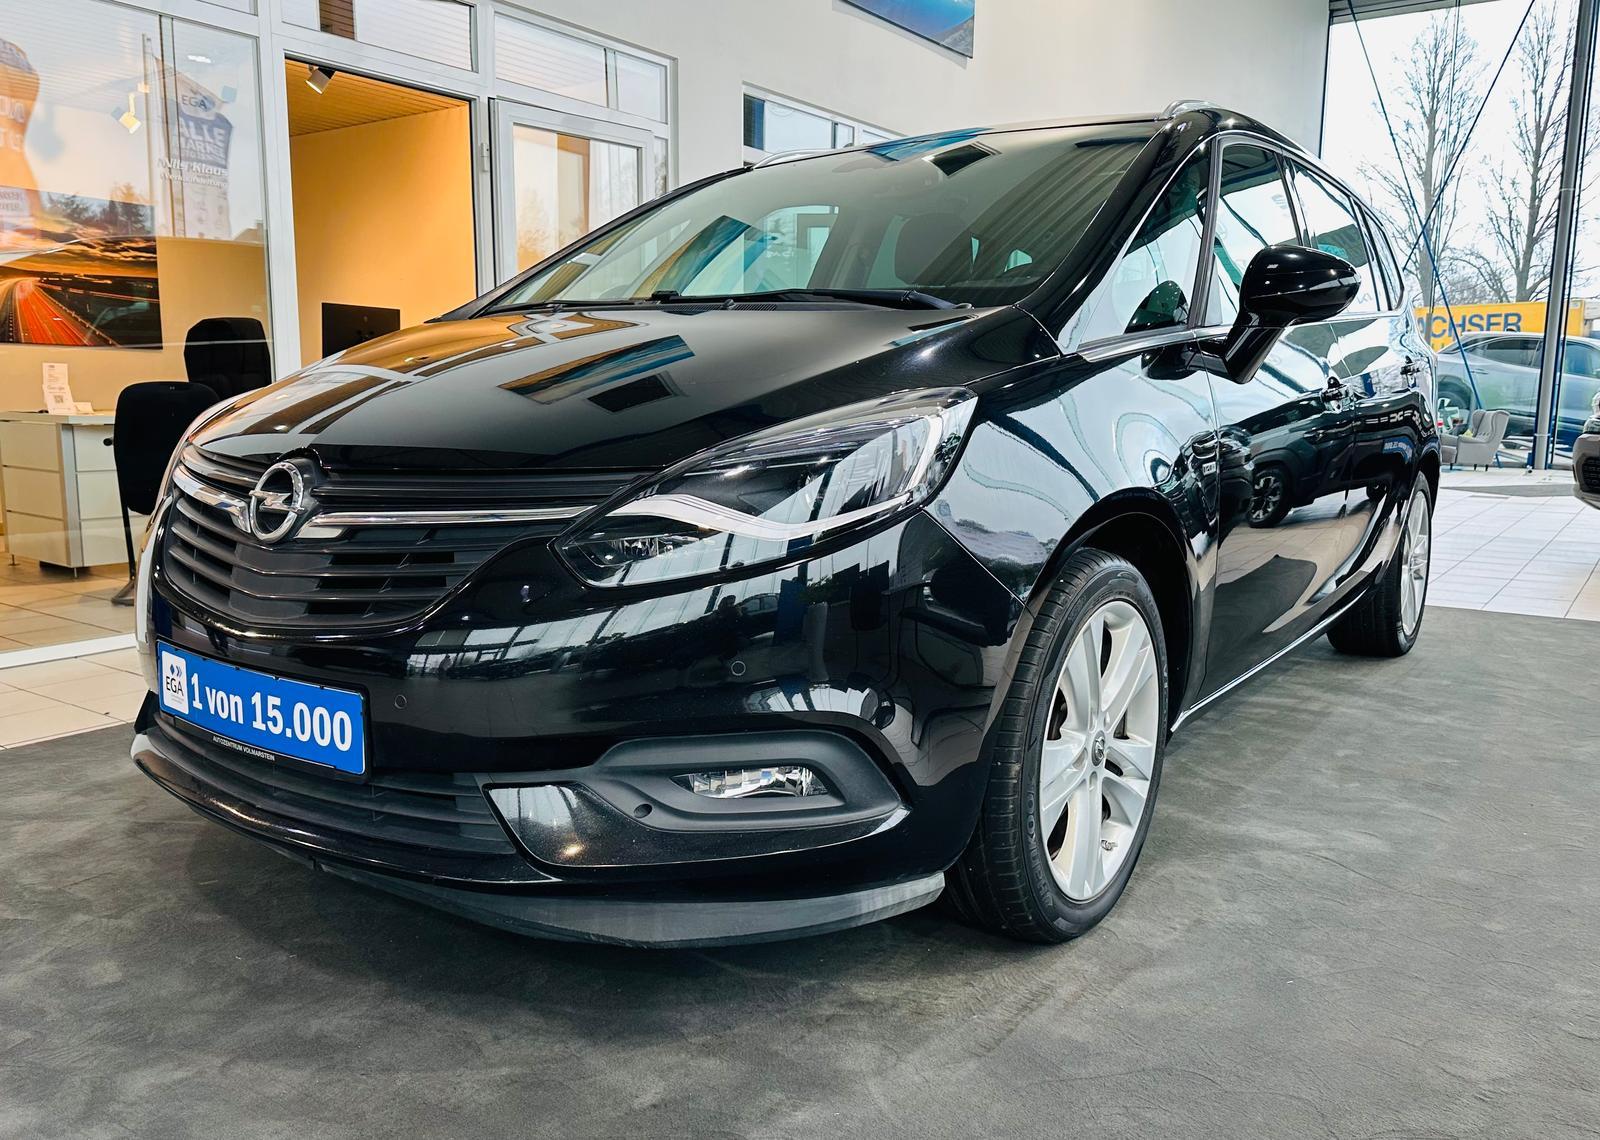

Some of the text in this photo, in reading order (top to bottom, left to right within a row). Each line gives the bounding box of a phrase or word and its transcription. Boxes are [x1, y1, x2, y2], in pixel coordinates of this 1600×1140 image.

[181, 95, 208, 110] EGA
[165, 675, 185, 697] EGA
[191, 672, 353, 752] 1 von 15.000
[242, 746, 276, 762] VOLMARSTEIN
